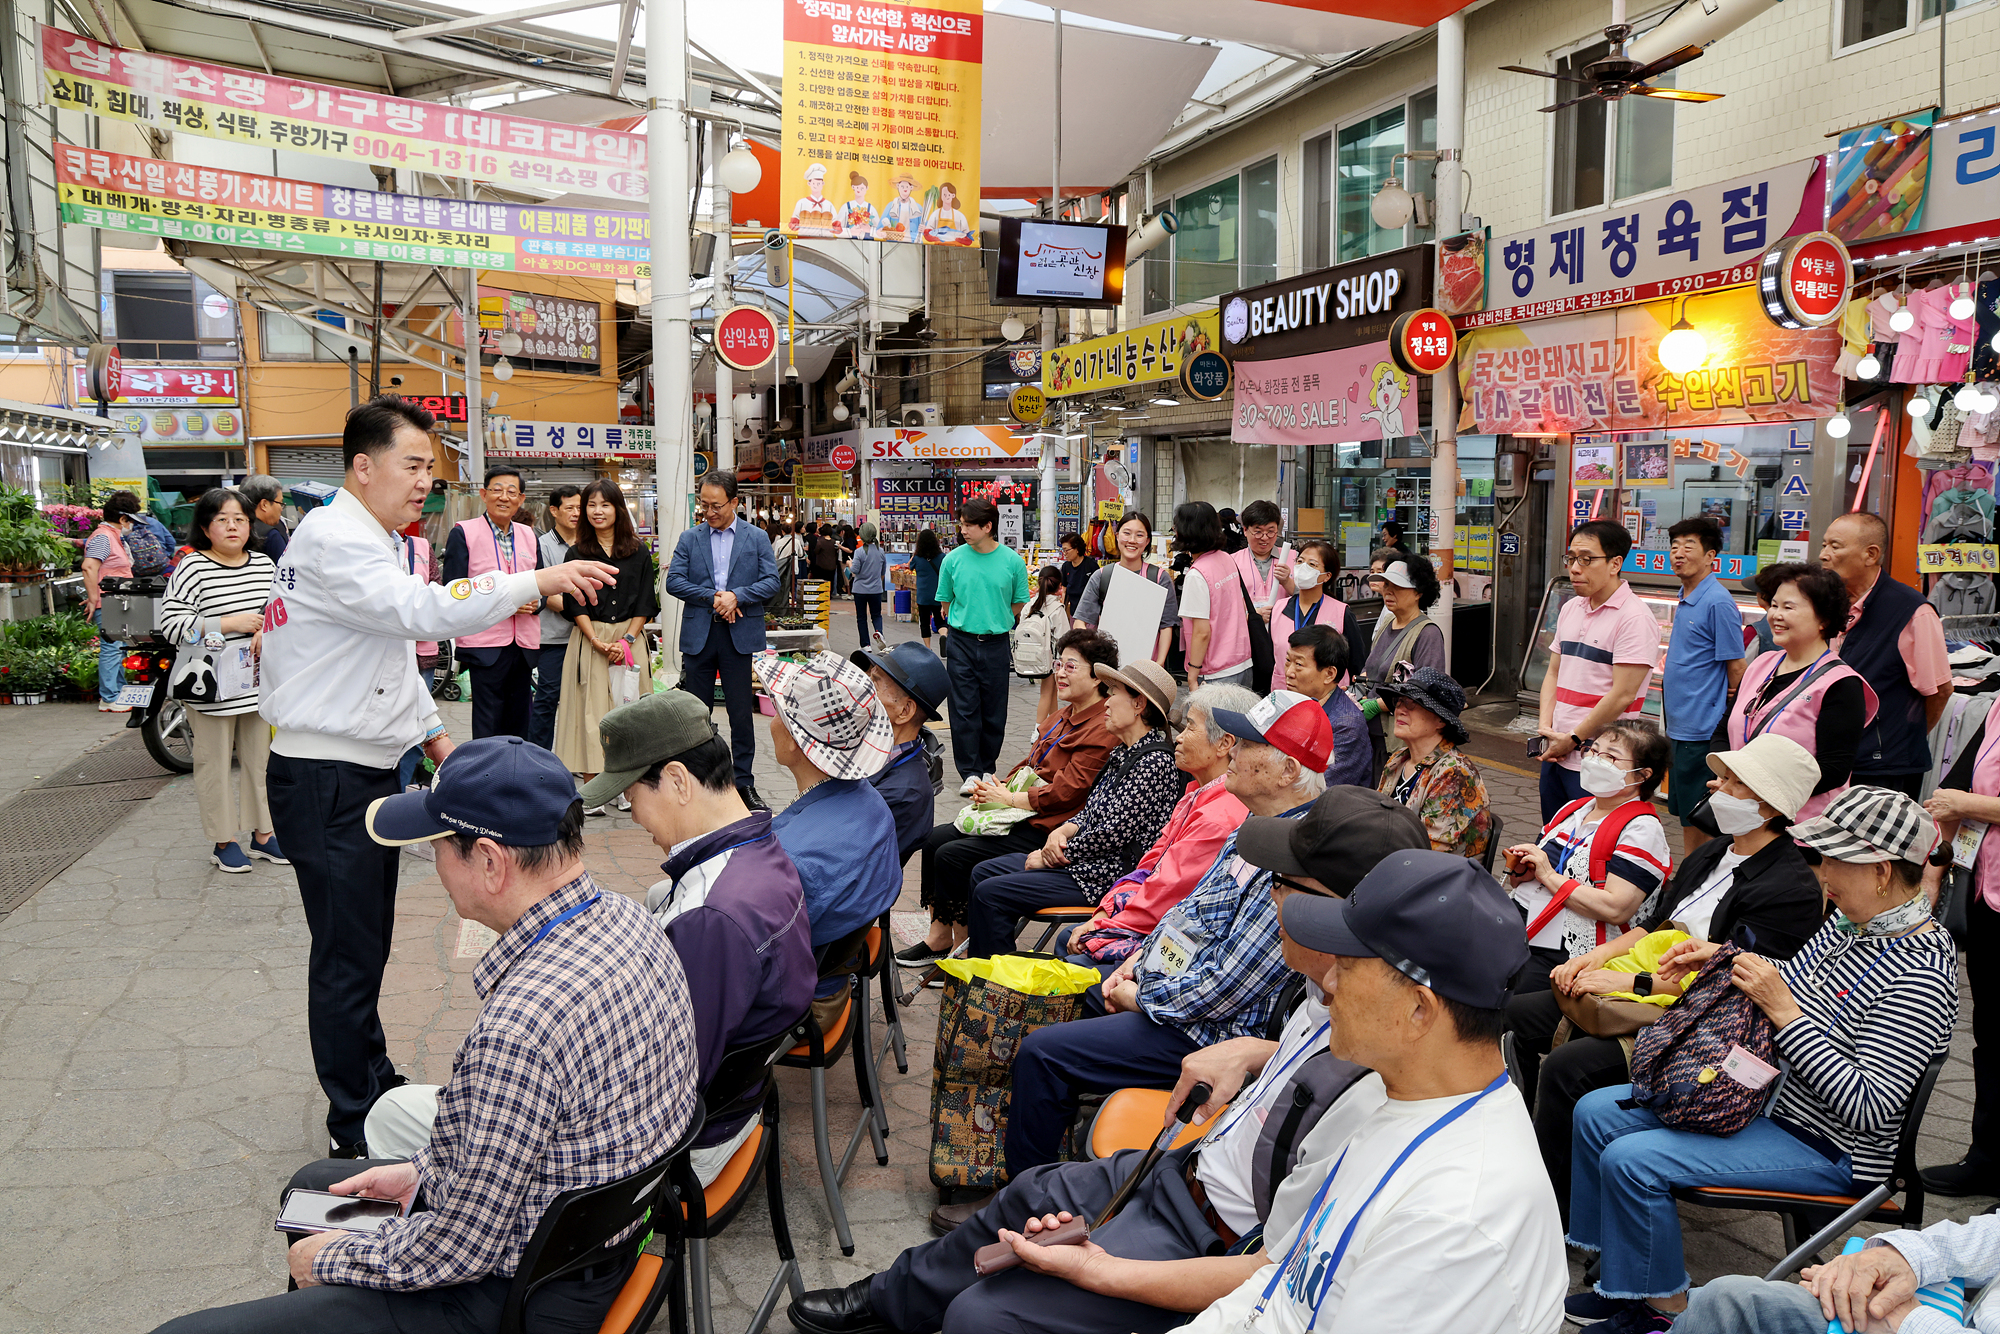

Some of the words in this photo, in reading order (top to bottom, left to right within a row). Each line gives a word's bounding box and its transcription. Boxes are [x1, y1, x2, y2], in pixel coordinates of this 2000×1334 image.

[856, 9, 907, 29] 신선함,
[911, 13, 971, 36] 혁신으로
[832, 24, 894, 49] 앞서가는
[808, 51, 833, 62] 정직한
[835, 54, 868, 67] 가격으로
[871, 59, 895, 70] 신뢰를
[897, 61, 940, 75] 약속합니다.
[62, 38, 267, 106] 삼익쇼핑
[288, 85, 427, 133] 가구방
[810, 68, 835, 80] 신선한
[837, 71, 870, 83] 상품으로
[872, 74, 896, 86] 가족의
[898, 77, 923, 89] 밥상을
[925, 80, 960, 92] 지킵니다.
[809, 84, 834, 96] 다양한
[837, 87, 870, 99] 업종으로
[872, 91, 888, 101] 삶의
[890, 93, 915, 104] 가치를
[917, 96, 951, 108] 더합니다.
[809, 100, 843, 112] 깨끗하고
[845, 104, 870, 116] 안전한
[871, 106, 896, 118] 환경을
[898, 108, 941, 122] 책임집니다.
[52, 78, 98, 108] 쇼파,
[107, 88, 154, 121] 침대,
[162, 100, 208, 130] 책상,
[216, 111, 261, 140] 식탁,
[270, 120, 347, 153] 주방가구
[353, 135, 498, 175] 904-1316
[508, 160, 598, 189] 삼익쇼핑
[809, 117, 834, 128] 고객의
[836, 119, 869, 131] 목소리에
[871, 122, 880, 132] 귀
[882, 123, 914, 135] 기울이며
[916, 126, 959, 140] 소통합니다.
[809, 133, 825, 143] 믿고
[828, 135, 836, 144] 더
[838, 135, 855, 146] 찾고
[857, 137, 874, 148] 싶은
[875, 139, 899, 150] 시장이
[901, 141, 945, 154] 되겠습니다.
[807, 148, 833, 160] 전통을
[834, 151, 860, 162] 살리며
[862, 153, 894, 166] 혁신으로
[896, 156, 921, 168] 발전을
[923, 158, 965, 172] 이어갑니다.
[519, 209, 587, 237] 여름제품
[1503, 181, 1768, 297] 형제정육점
[528, 240, 567, 255] 판촉물
[572, 243, 597, 256] 주문
[602, 245, 650, 260] 받습니다
[523, 257, 628, 275] 아울렛DC백화점
[1074, 264, 1099, 279] 신창
[1801, 257, 1836, 276] 아동복
[1795, 280, 1839, 299] 리틀랜드
[1251, 283, 1332, 337] BEAUTY
[1336, 268, 1400, 320] SHOP
[1422, 322, 1436, 331] 형제
[724, 327, 769, 349] 삼익쇼핑
[1410, 337, 1447, 356] 정육점
[1018, 351, 1033, 361] PC
[1074, 326, 1177, 383] 이가네농수산
[1199, 360, 1217, 368] 마돈나
[1476, 336, 1635, 382] 국산암돼지고기
[1193, 370, 1225, 386] 화장품
[1264, 378, 1288, 395] 화장품
[1292, 376, 1300, 392] 전
[1303, 374, 1320, 391] 품목
[1656, 360, 1809, 412] 수입쇠고기
[1017, 395, 1040, 403] 이가네
[1019, 403, 1038, 414] 농수산
[1239, 403, 1296, 429] 30~70%
[515, 424, 622, 449] 금성의류
[872, 441, 903, 457] SK
[913, 443, 991, 457] telecom
[882, 480, 901, 492] SK
[906, 480, 923, 492] KT
[928, 480, 945, 492] LG
[880, 496, 949, 512] 모든통신사
[1059, 494, 1079, 502] 동네에서
[1057, 503, 1079, 515] 가장싼
[1504, 543, 1515, 552] 25
[125, 694, 147, 703] 3531
[480, 827, 503, 838] Division
